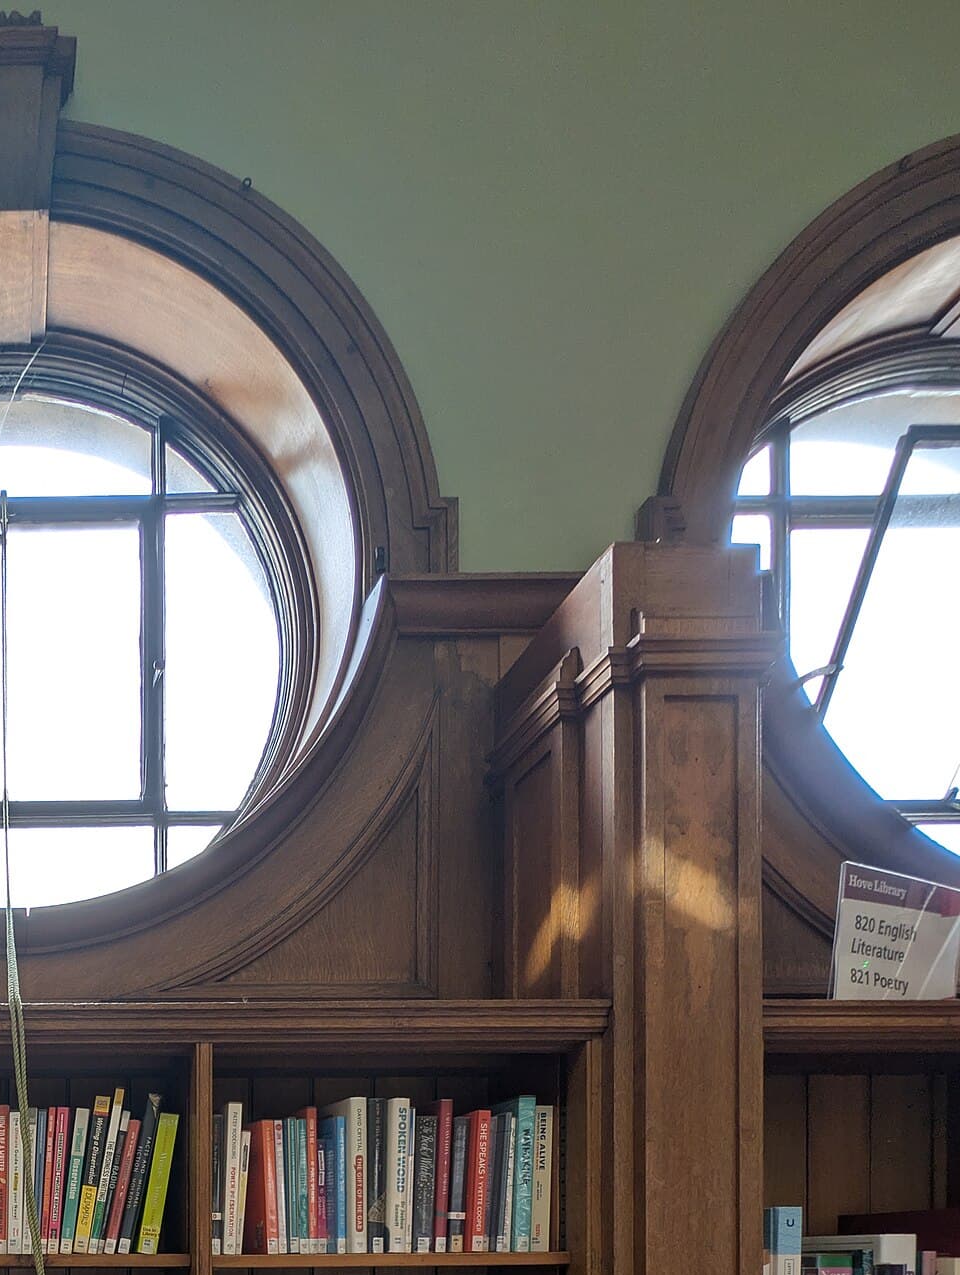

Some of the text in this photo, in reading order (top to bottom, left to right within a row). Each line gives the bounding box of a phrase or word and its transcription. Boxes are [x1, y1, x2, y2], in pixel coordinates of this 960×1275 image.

[849, 875, 907, 900] Hove Library
[855, 915, 917, 942] 820 English
[851, 938, 904, 962] Literature
[850, 969, 909, 995] 821 Poetry
[95, 1118, 104, 1140] Writing
[134, 1146, 142, 1172] FICTION
[397, 1107, 406, 1193] SPOKEN WORD
[88, 1146, 100, 1184] Dissertation
[109, 1165, 119, 1189] RADIO
[69, 1158, 79, 1199] Dissertation
[357, 1190, 362, 1198] OF
